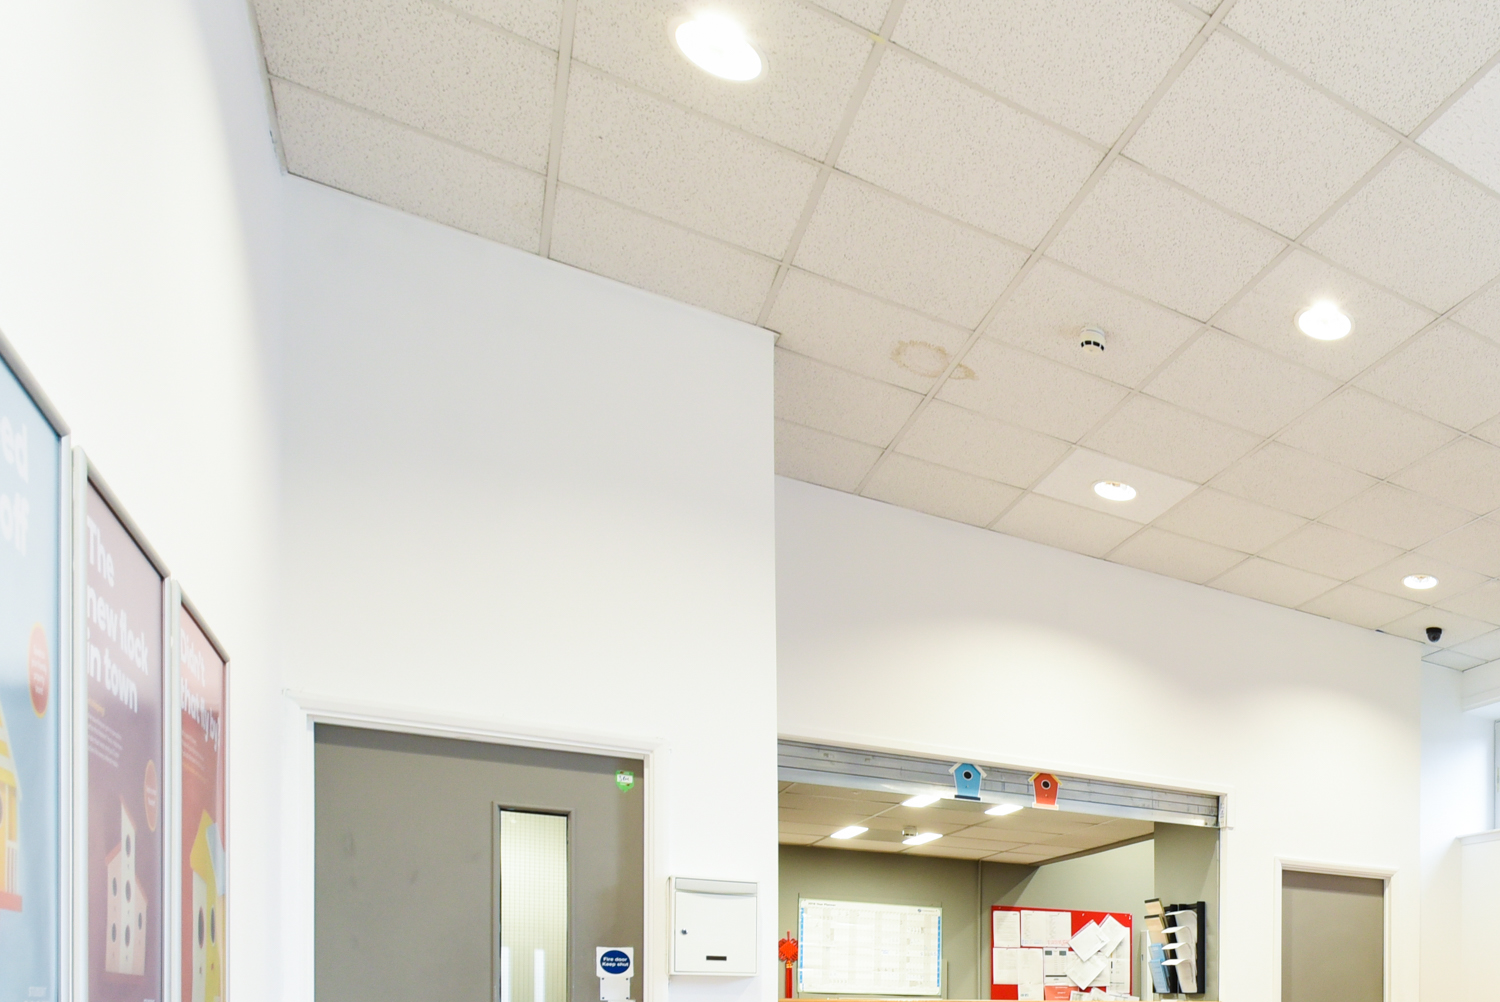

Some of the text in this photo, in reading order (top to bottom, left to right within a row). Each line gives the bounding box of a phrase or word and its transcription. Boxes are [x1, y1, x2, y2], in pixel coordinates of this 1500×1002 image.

[87, 515, 115, 587] The
[87, 585, 118, 643] new
[119, 608, 149, 676] flock
[87, 627, 102, 683] in
[104, 647, 138, 714] town
